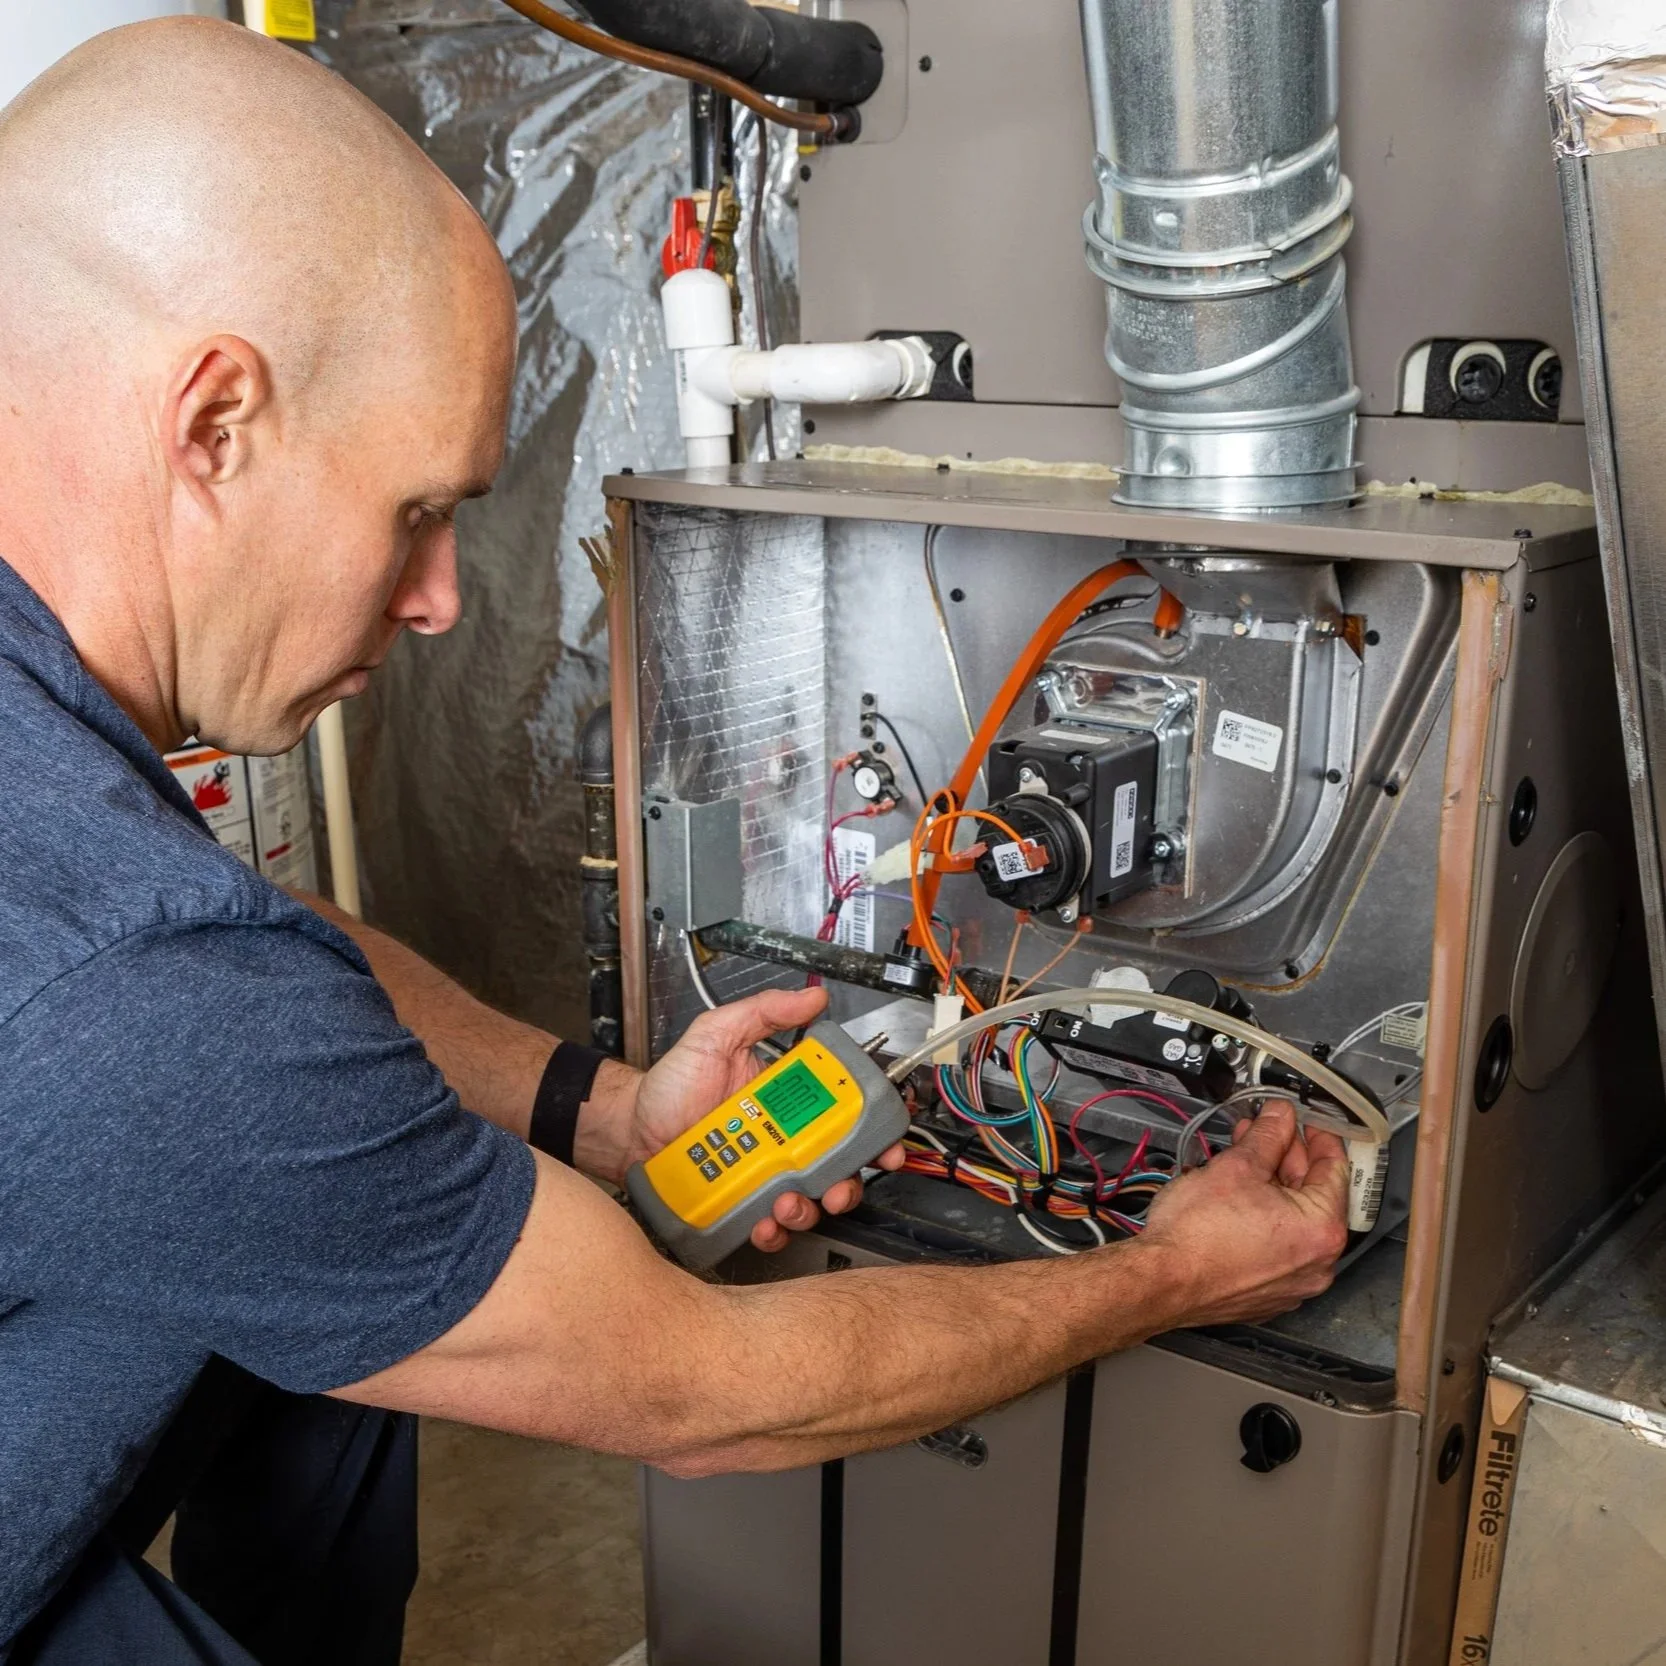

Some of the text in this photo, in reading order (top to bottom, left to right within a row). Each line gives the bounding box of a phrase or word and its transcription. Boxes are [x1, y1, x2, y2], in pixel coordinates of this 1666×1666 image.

[1070, 1020, 1083, 1038] ON
[762, 1120, 786, 1146] EM201B
[1478, 1430, 1516, 1537] Filtrete
